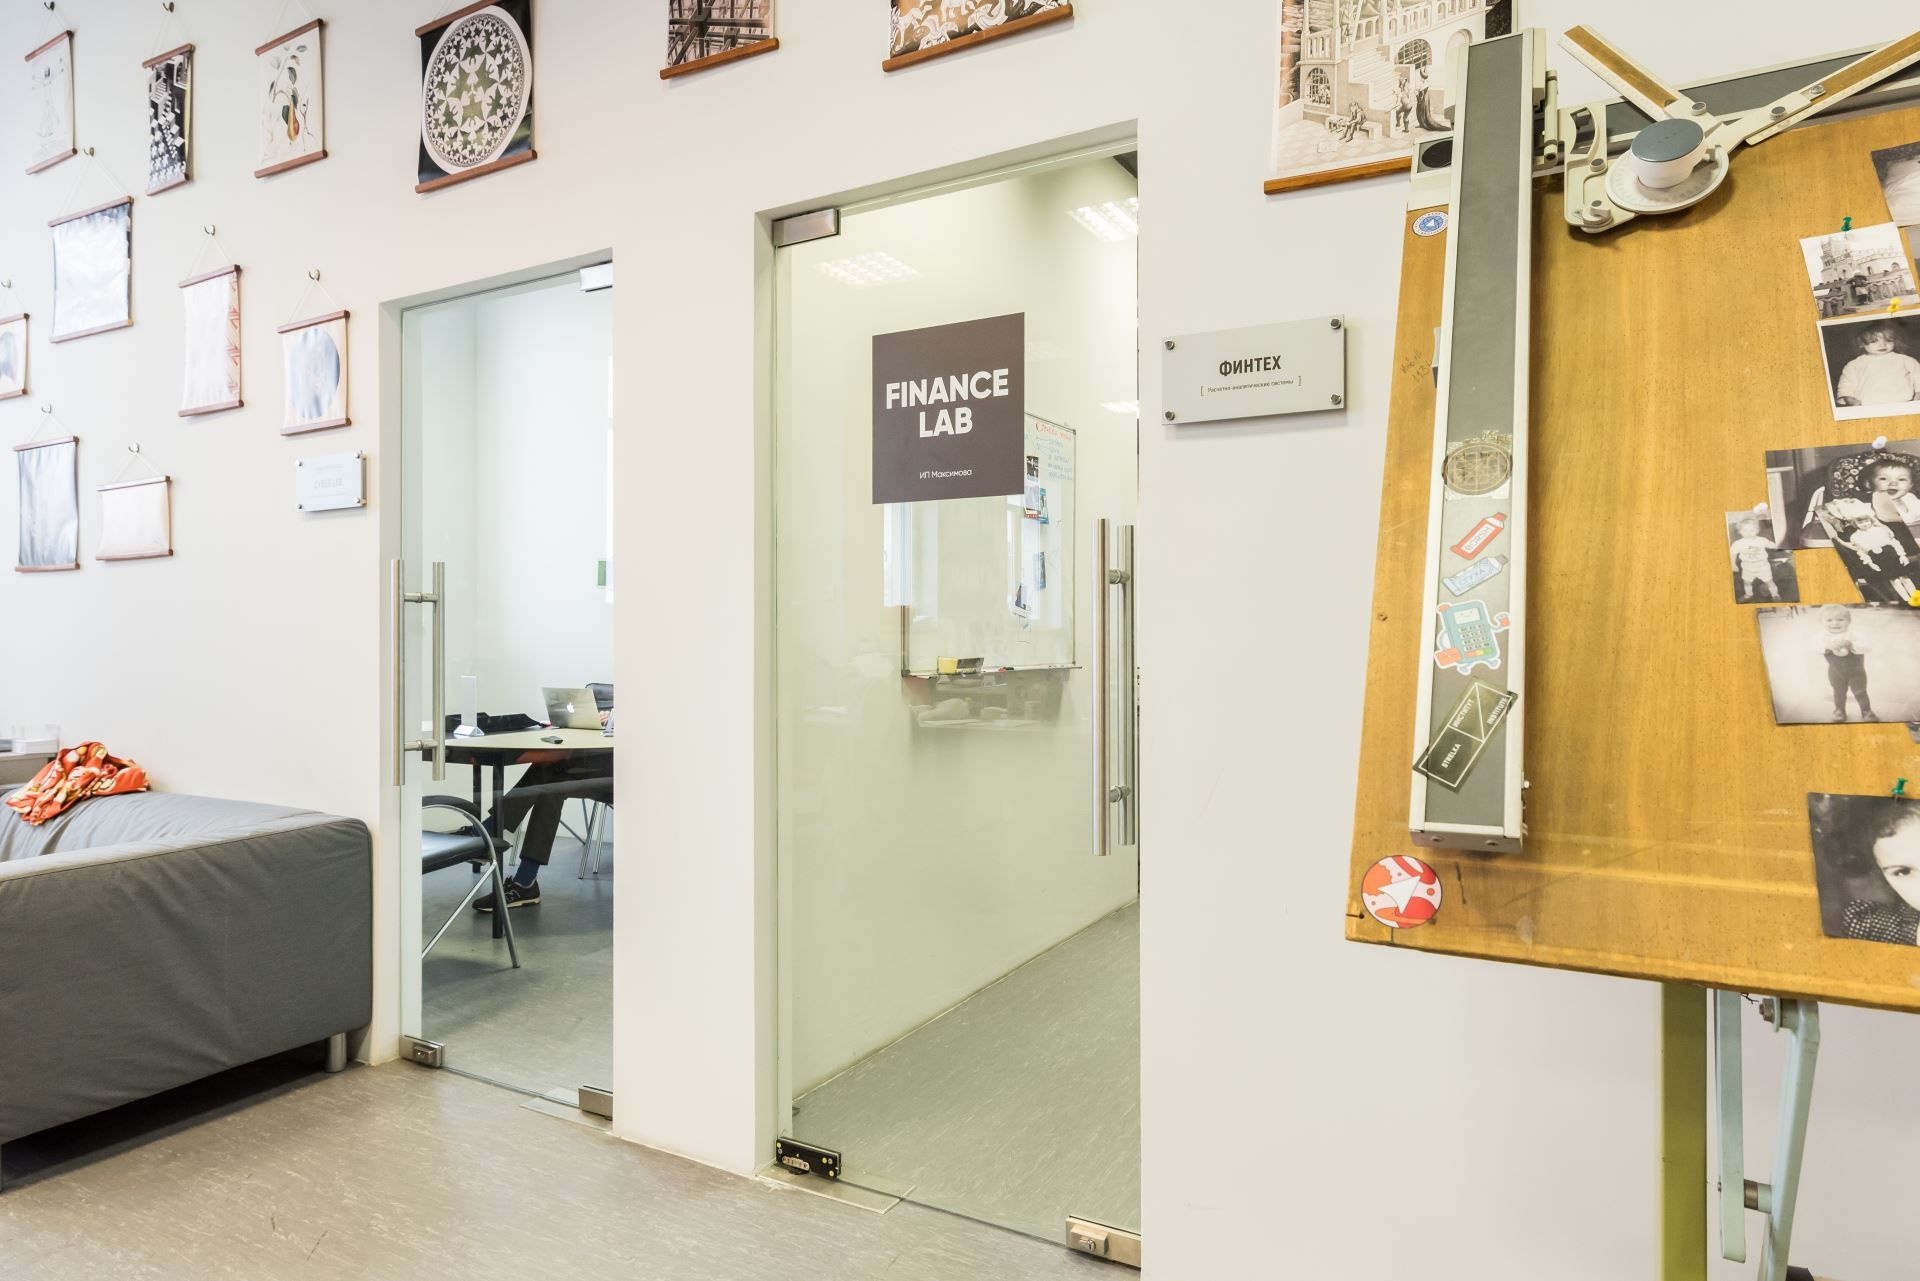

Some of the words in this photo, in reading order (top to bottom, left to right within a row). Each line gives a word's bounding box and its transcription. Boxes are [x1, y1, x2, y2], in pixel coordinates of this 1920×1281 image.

[1219, 355, 1282, 377] ФИНТЕХ
[886, 368, 1009, 410] FINANCE
[919, 406, 973, 438] LAB
[919, 470, 931, 480] ИП
[931, 468, 973, 479] Максимова
[1452, 698, 1473, 728] ИНСТИТУТ
[1441, 743, 1462, 769] STRELKA
